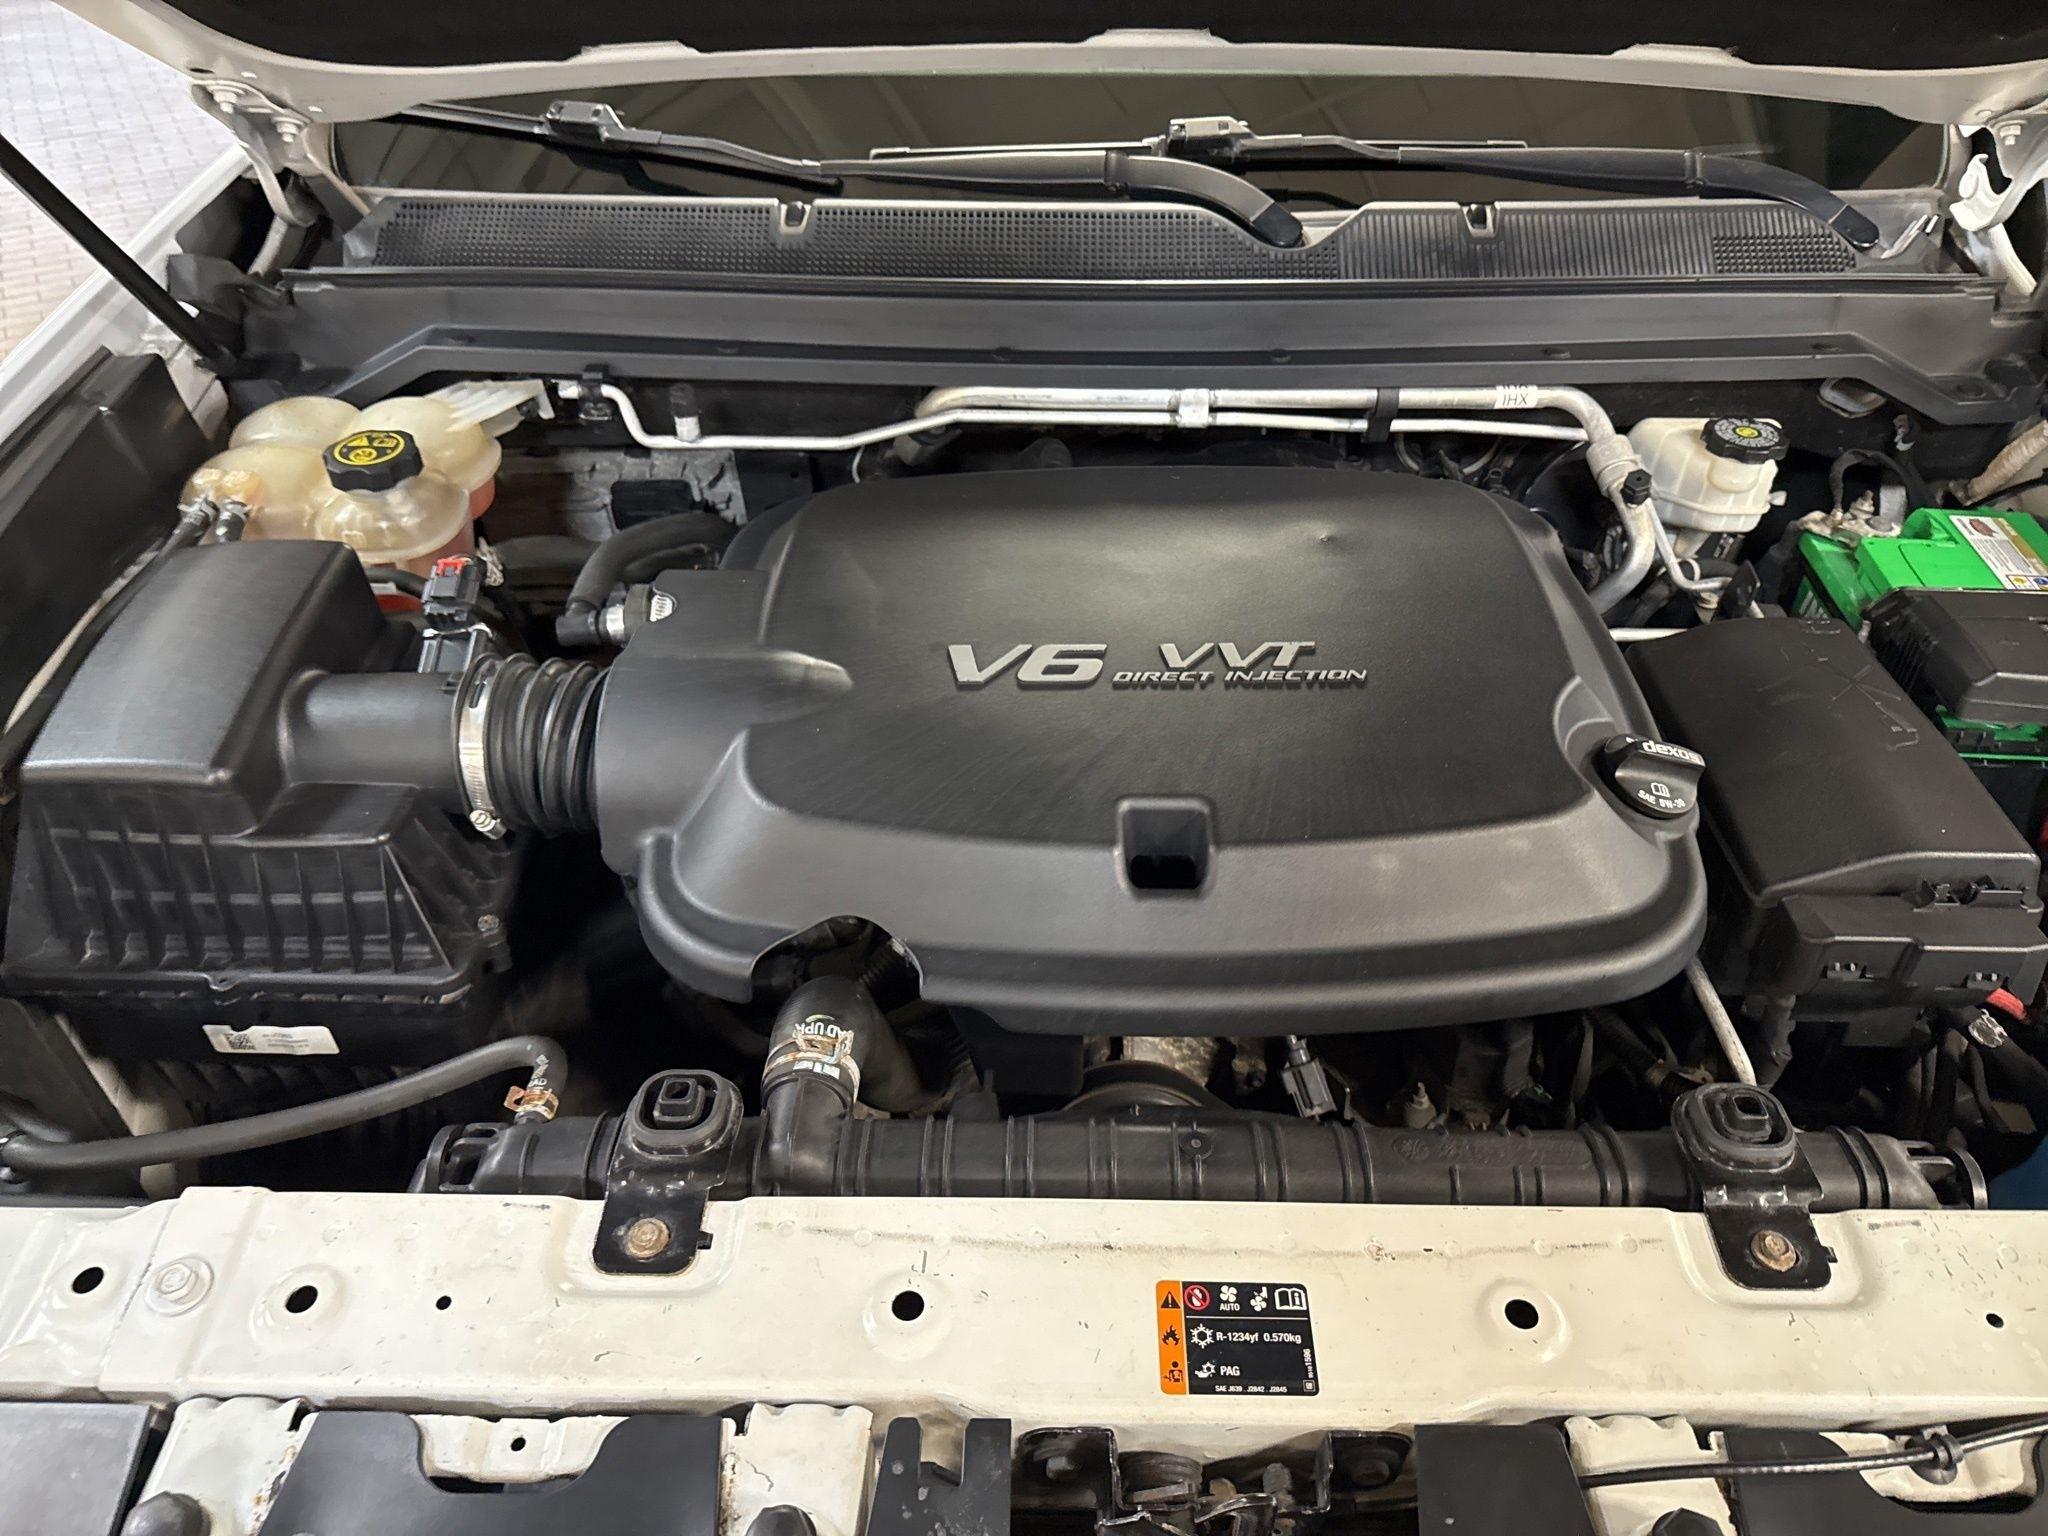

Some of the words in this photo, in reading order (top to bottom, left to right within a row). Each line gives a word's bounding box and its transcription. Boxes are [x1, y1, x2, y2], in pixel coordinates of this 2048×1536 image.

[948, 643, 1108, 687] V6
[1160, 640, 1316, 671] VVT
[1112, 669, 1215, 685] DIRECT
[1225, 667, 1368, 685] INJECTION
[1637, 789, 1656, 805] SAE
[1658, 798, 1686, 809] 5W-30
[1219, 1302, 1240, 1311] AUTO
[1216, 1332, 1259, 1343] R-1234yf
[1263, 1333, 1302, 1344] 0.570kg
[1220, 1365, 1241, 1377] PAG
